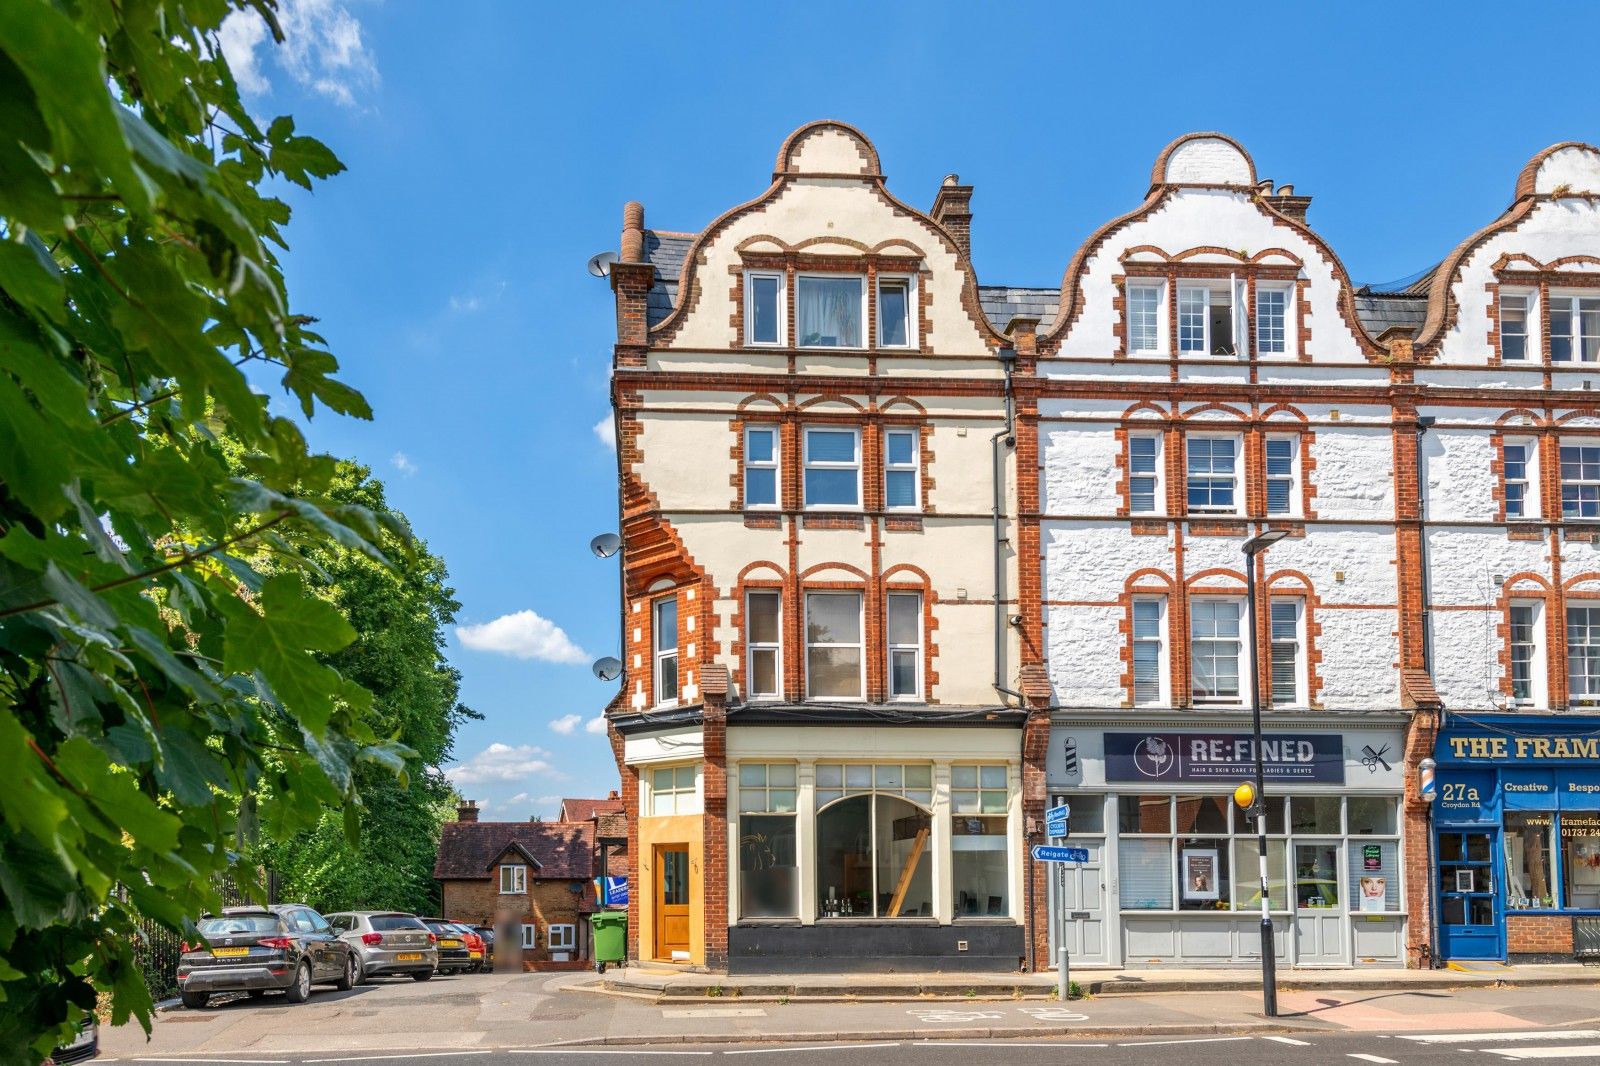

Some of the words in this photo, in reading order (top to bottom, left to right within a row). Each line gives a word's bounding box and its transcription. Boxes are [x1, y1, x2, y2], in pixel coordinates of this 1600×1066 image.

[1190, 740, 1314, 762] RE:FINED
[1450, 738, 1508, 758] THE
[1515, 738, 1600, 758] FRAM
[1442, 783, 1480, 801] 27a
[1504, 783, 1549, 792] Creative
[1568, 783, 1600, 794] Bespo
[1526, 818, 1552, 826] www.
[1561, 828, 1588, 837] 01737
[1041, 850, 1068, 858] Reigate
